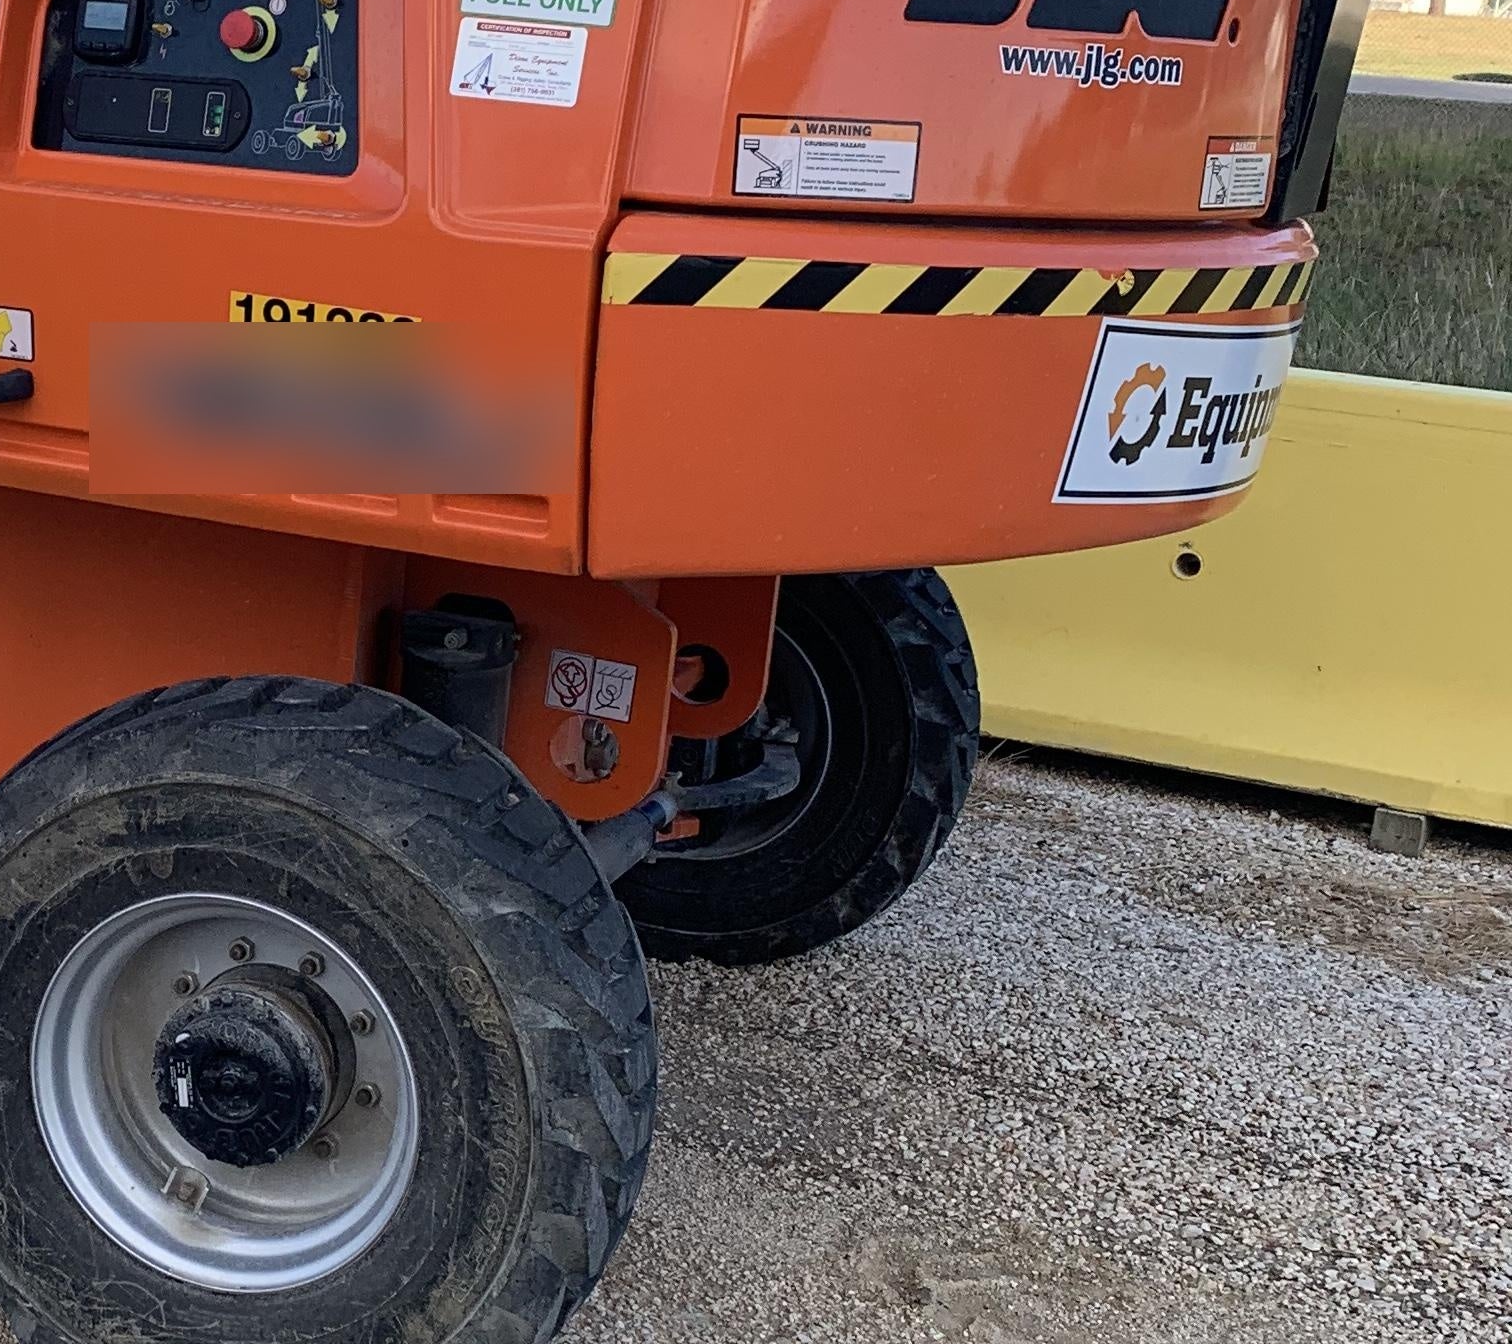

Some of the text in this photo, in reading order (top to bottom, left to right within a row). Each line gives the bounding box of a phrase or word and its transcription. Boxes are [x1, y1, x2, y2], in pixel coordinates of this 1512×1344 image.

[480, 23, 523, 34] CERTIFICATION
[532, 28, 568, 38] INSPECTION
[1001, 44, 1182, 86] www.jlg.com
[806, 122, 872, 137] WARNING
